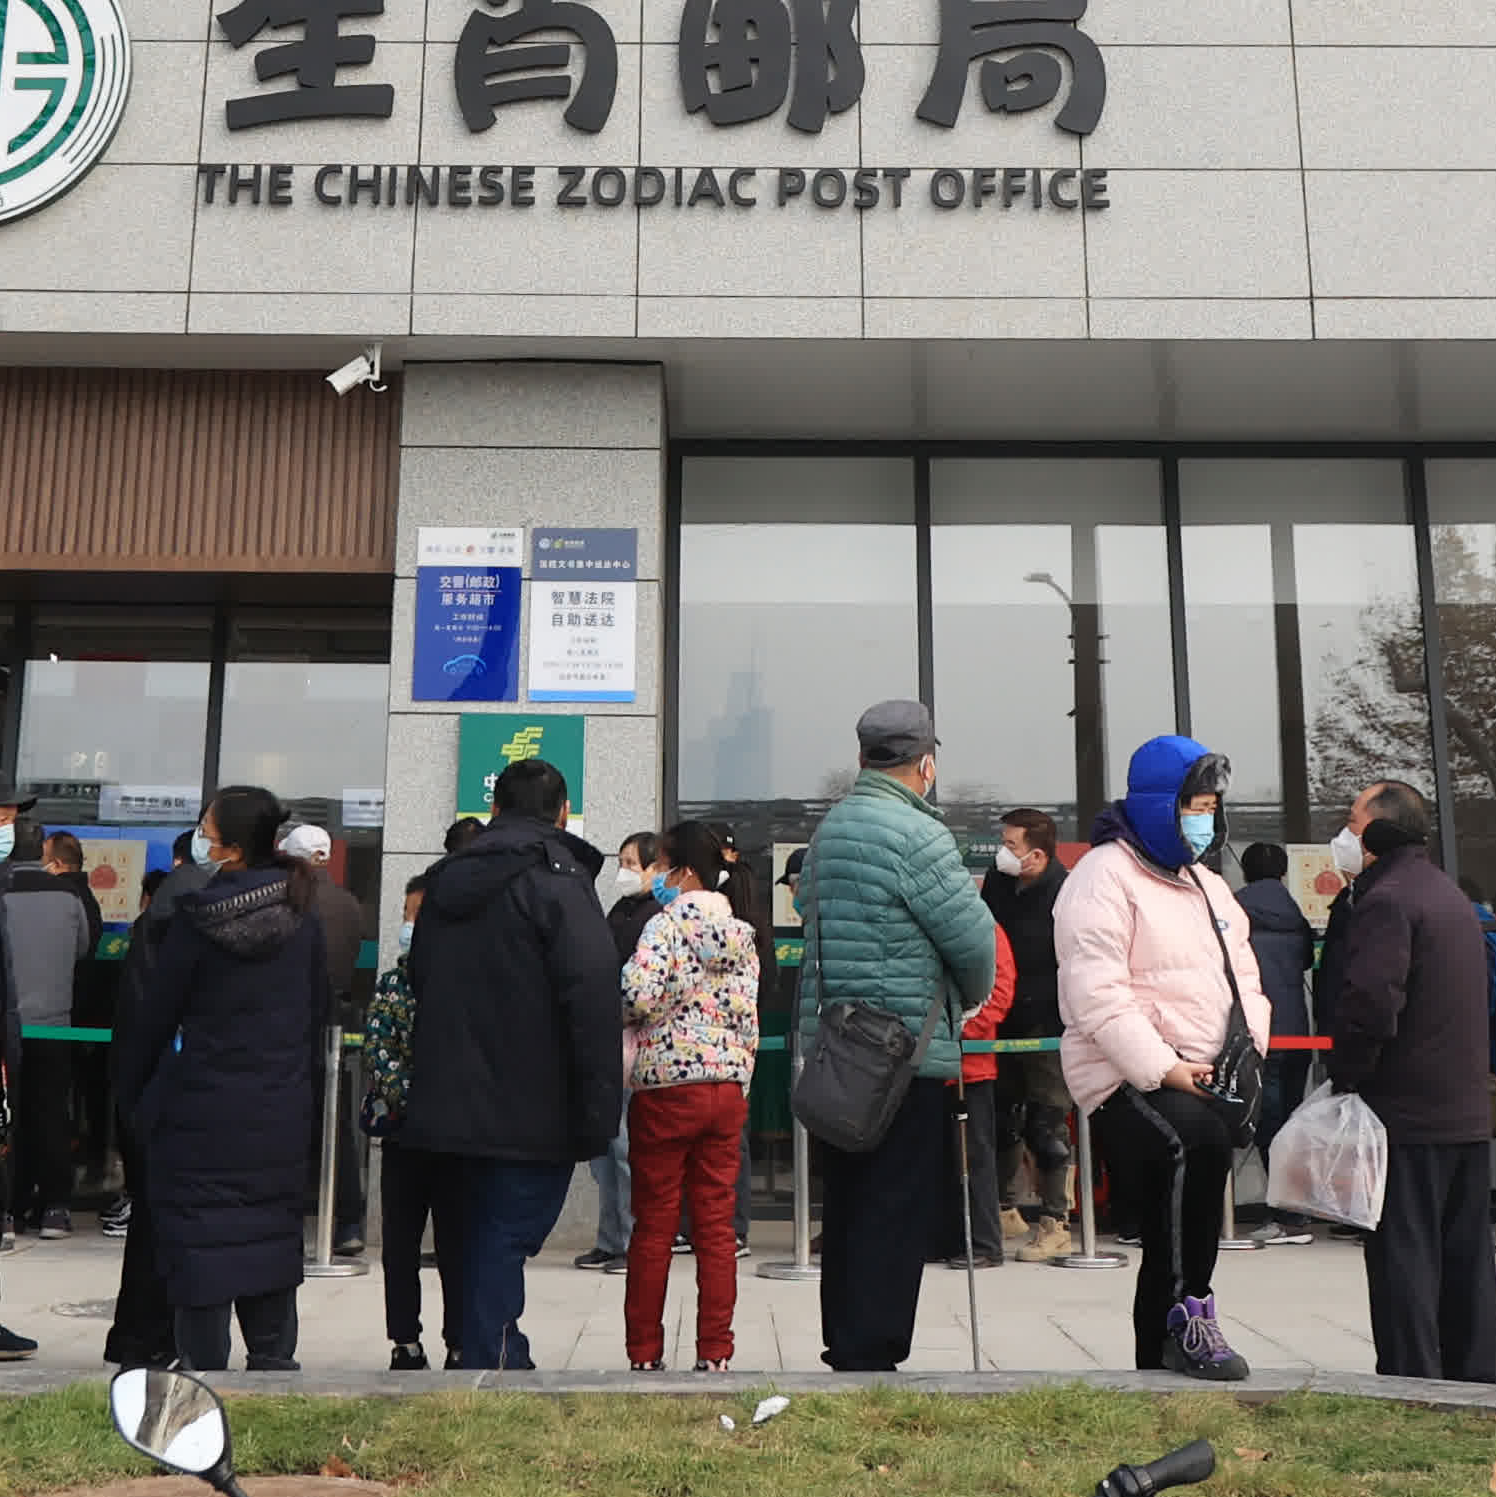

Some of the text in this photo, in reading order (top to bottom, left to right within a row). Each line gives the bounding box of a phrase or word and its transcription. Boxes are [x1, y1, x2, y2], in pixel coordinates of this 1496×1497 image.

[198, 164, 1110, 211] THE CHINESE ZODIAC POST OFFICE
[551, 591, 616, 606] 智慧法院
[551, 613, 616, 628] 自助送达
